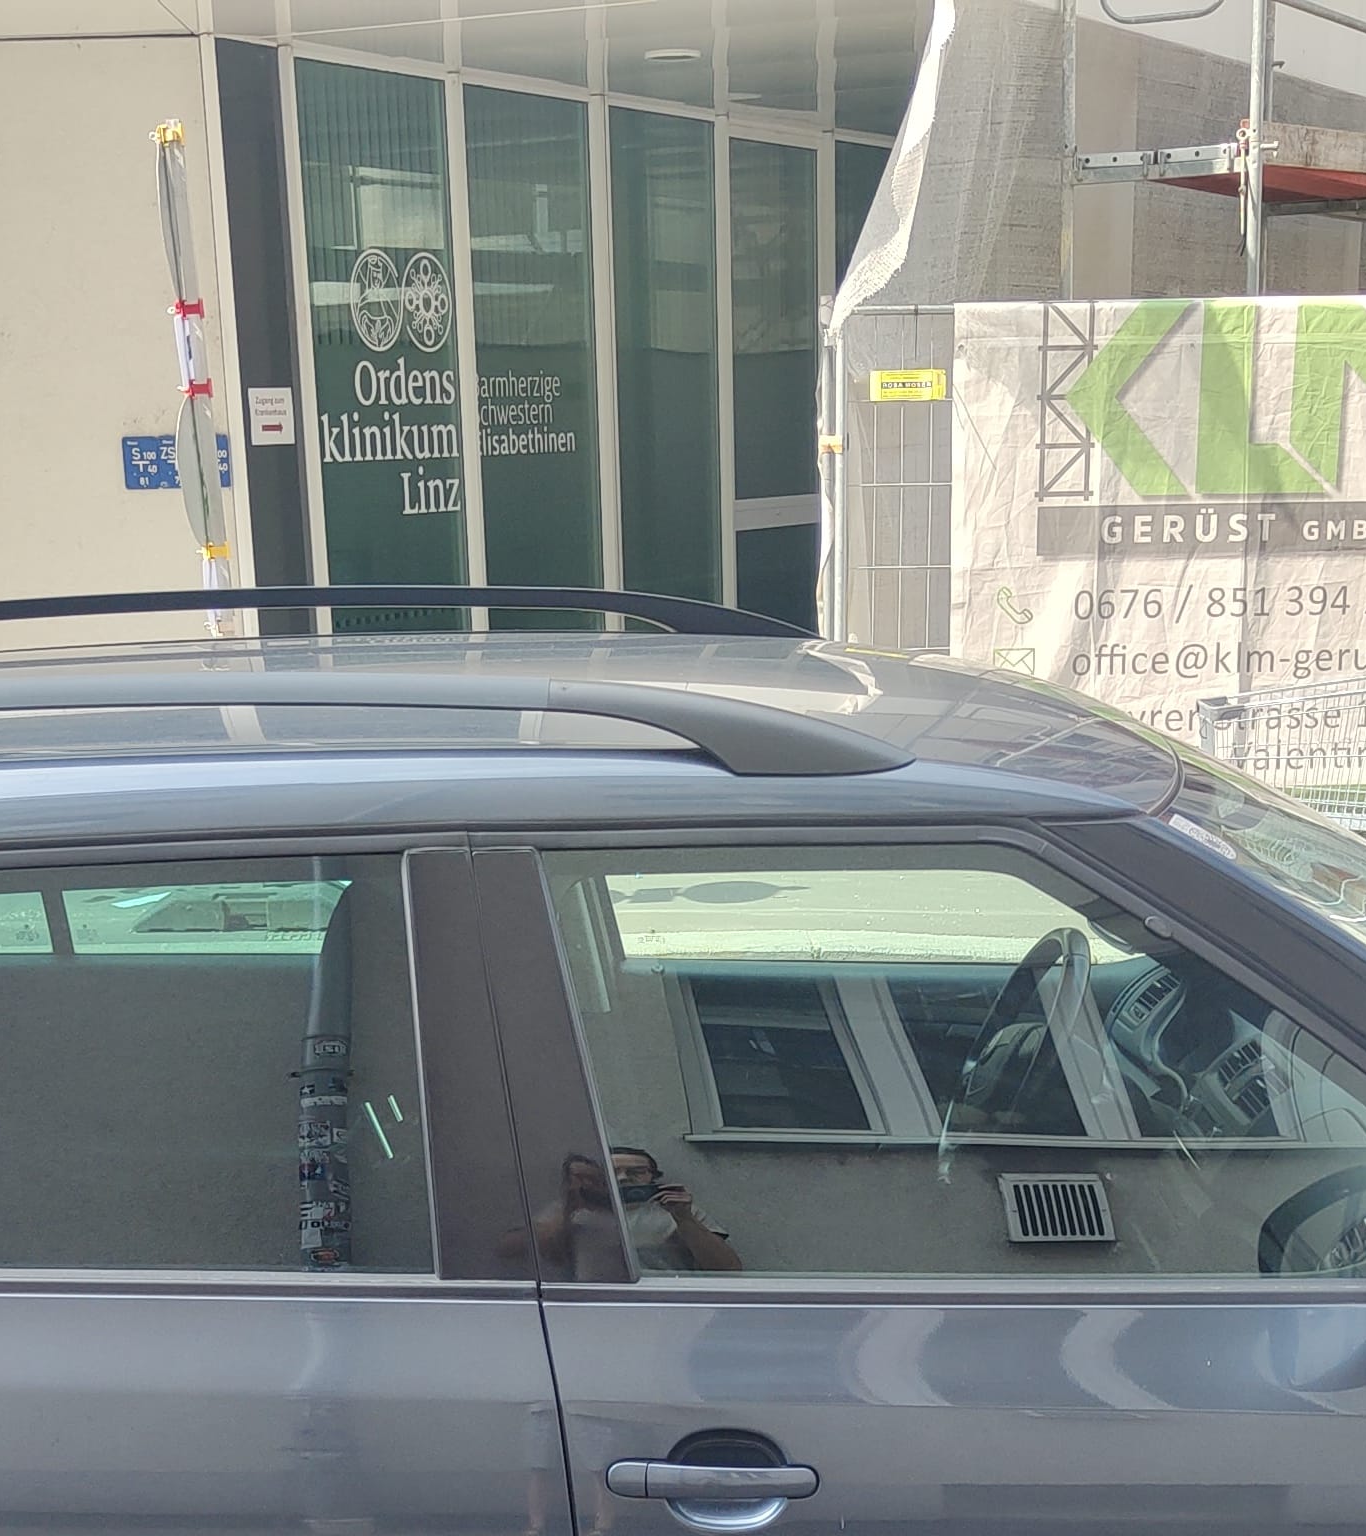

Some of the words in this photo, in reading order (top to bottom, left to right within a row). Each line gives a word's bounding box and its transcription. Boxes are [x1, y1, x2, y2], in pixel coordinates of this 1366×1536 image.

[353, 356, 456, 406] Ordens
[478, 398, 553, 427] chwestern
[320, 410, 460, 463] klinikum
[399, 465, 461, 515] Linz
[1100, 507, 1277, 546] GERÜST
[1073, 587, 1164, 621] 0676
[1175, 584, 1193, 624] /
[1206, 587, 1272, 618] 851
[1285, 585, 1351, 616] 394
